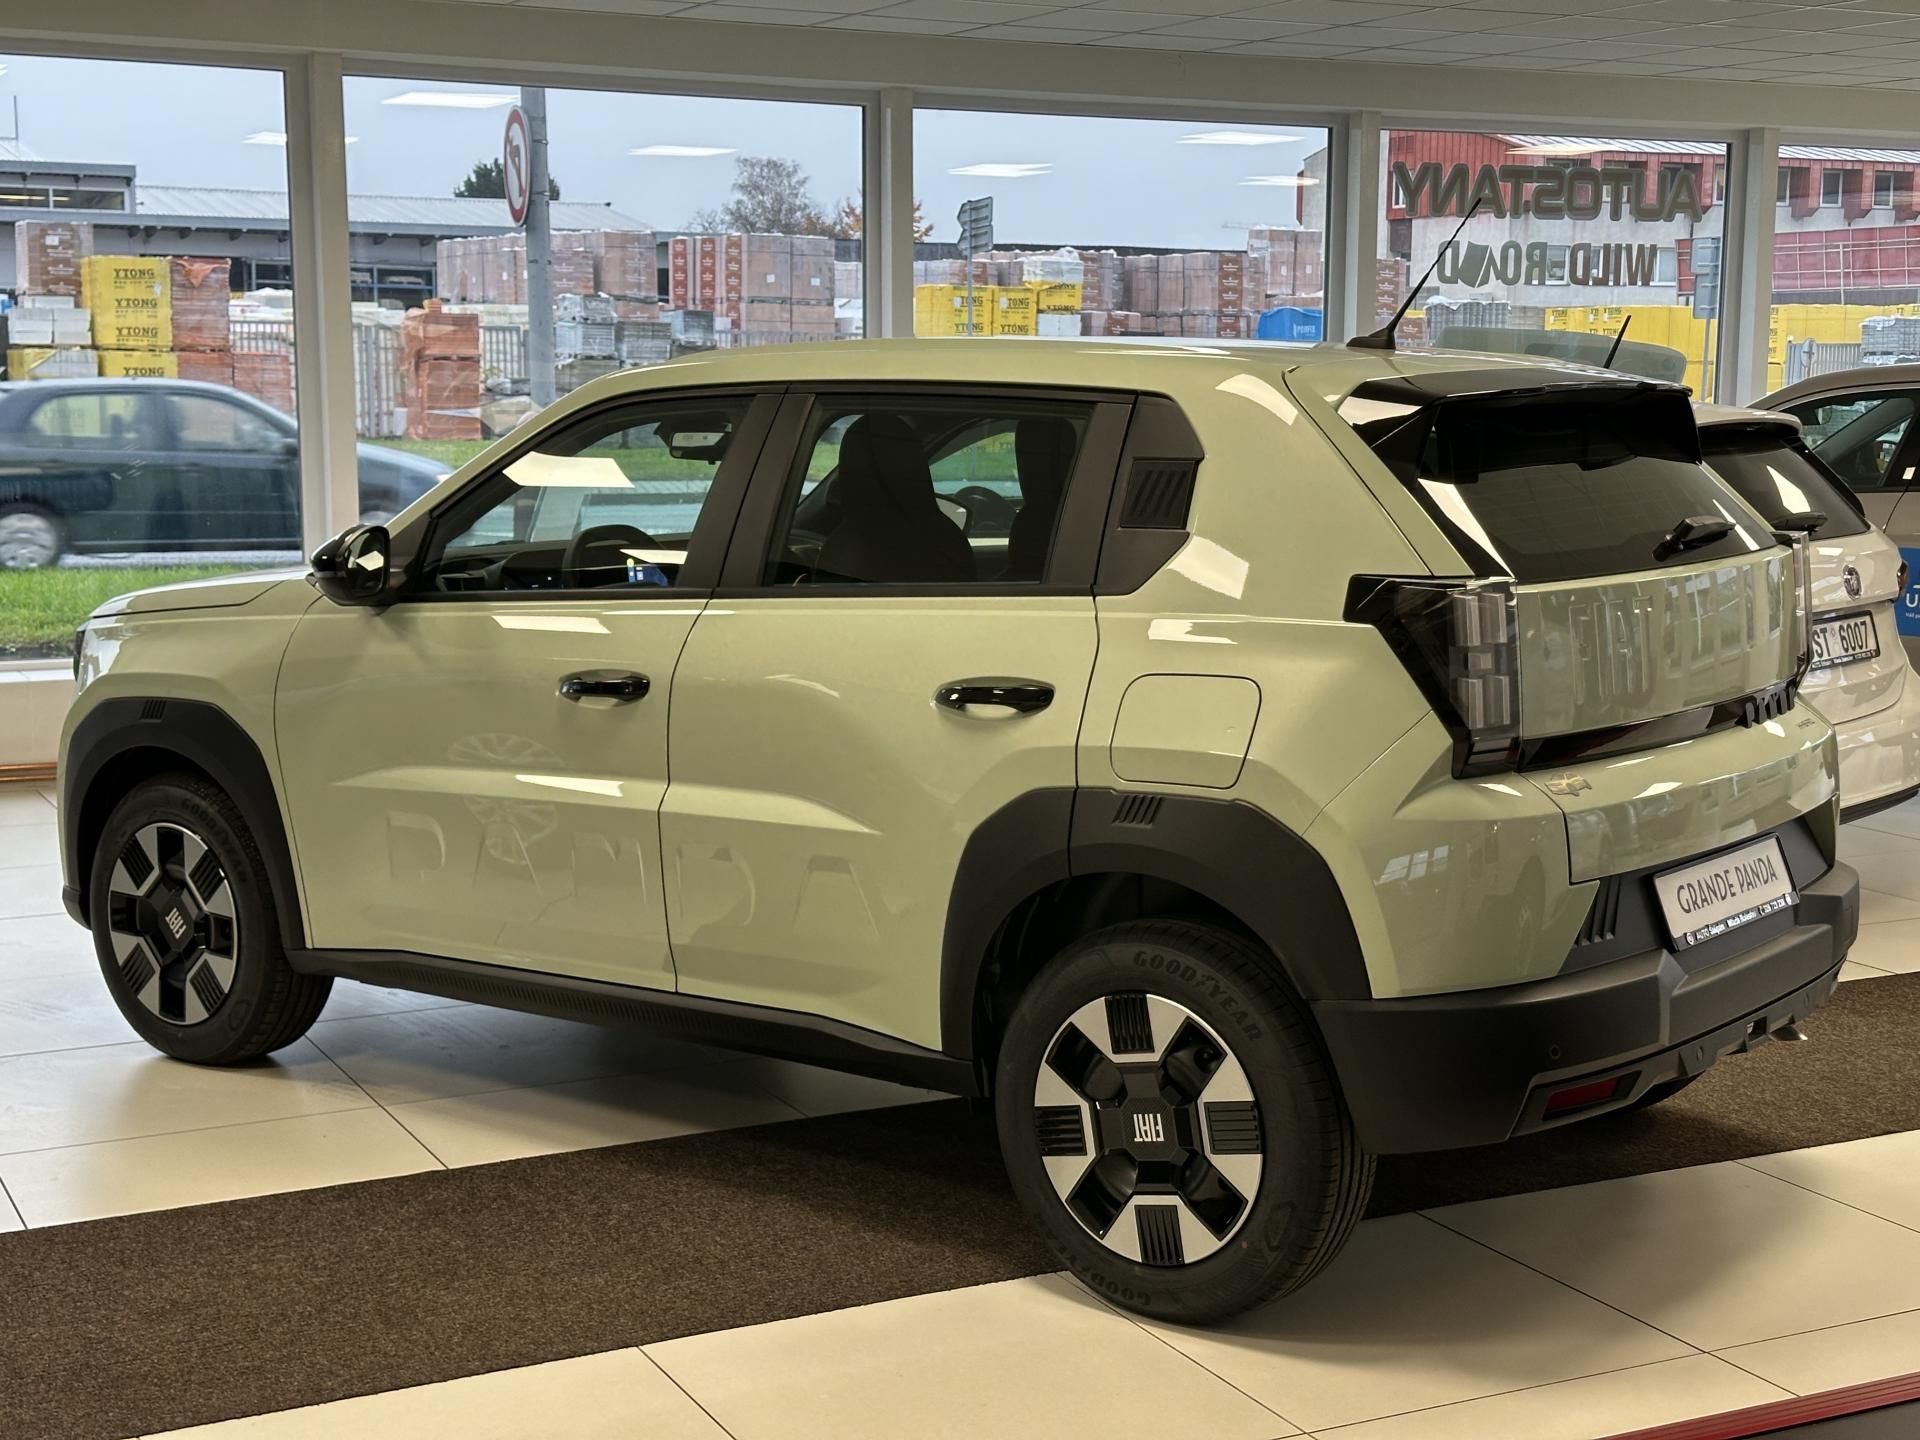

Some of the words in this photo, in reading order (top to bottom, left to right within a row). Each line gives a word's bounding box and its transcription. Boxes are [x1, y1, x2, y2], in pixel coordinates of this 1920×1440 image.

[114, 267, 155, 279] YTONG
[115, 298, 157, 308] YTONG
[1002, 297, 1030, 307] TONG
[116, 326, 158, 337] YTONG
[1000, 323, 1029, 333] YTONG
[123, 366, 165, 376] YTONG
[1838, 620, 1868, 654] 6007
[1676, 869, 1737, 914] GRANDE
[1734, 854, 1778, 894] PANDA
[165, 907, 187, 940] FIAT
[1133, 950, 1263, 1041] GOODYEAR
[1132, 1113, 1165, 1142] FIAT
